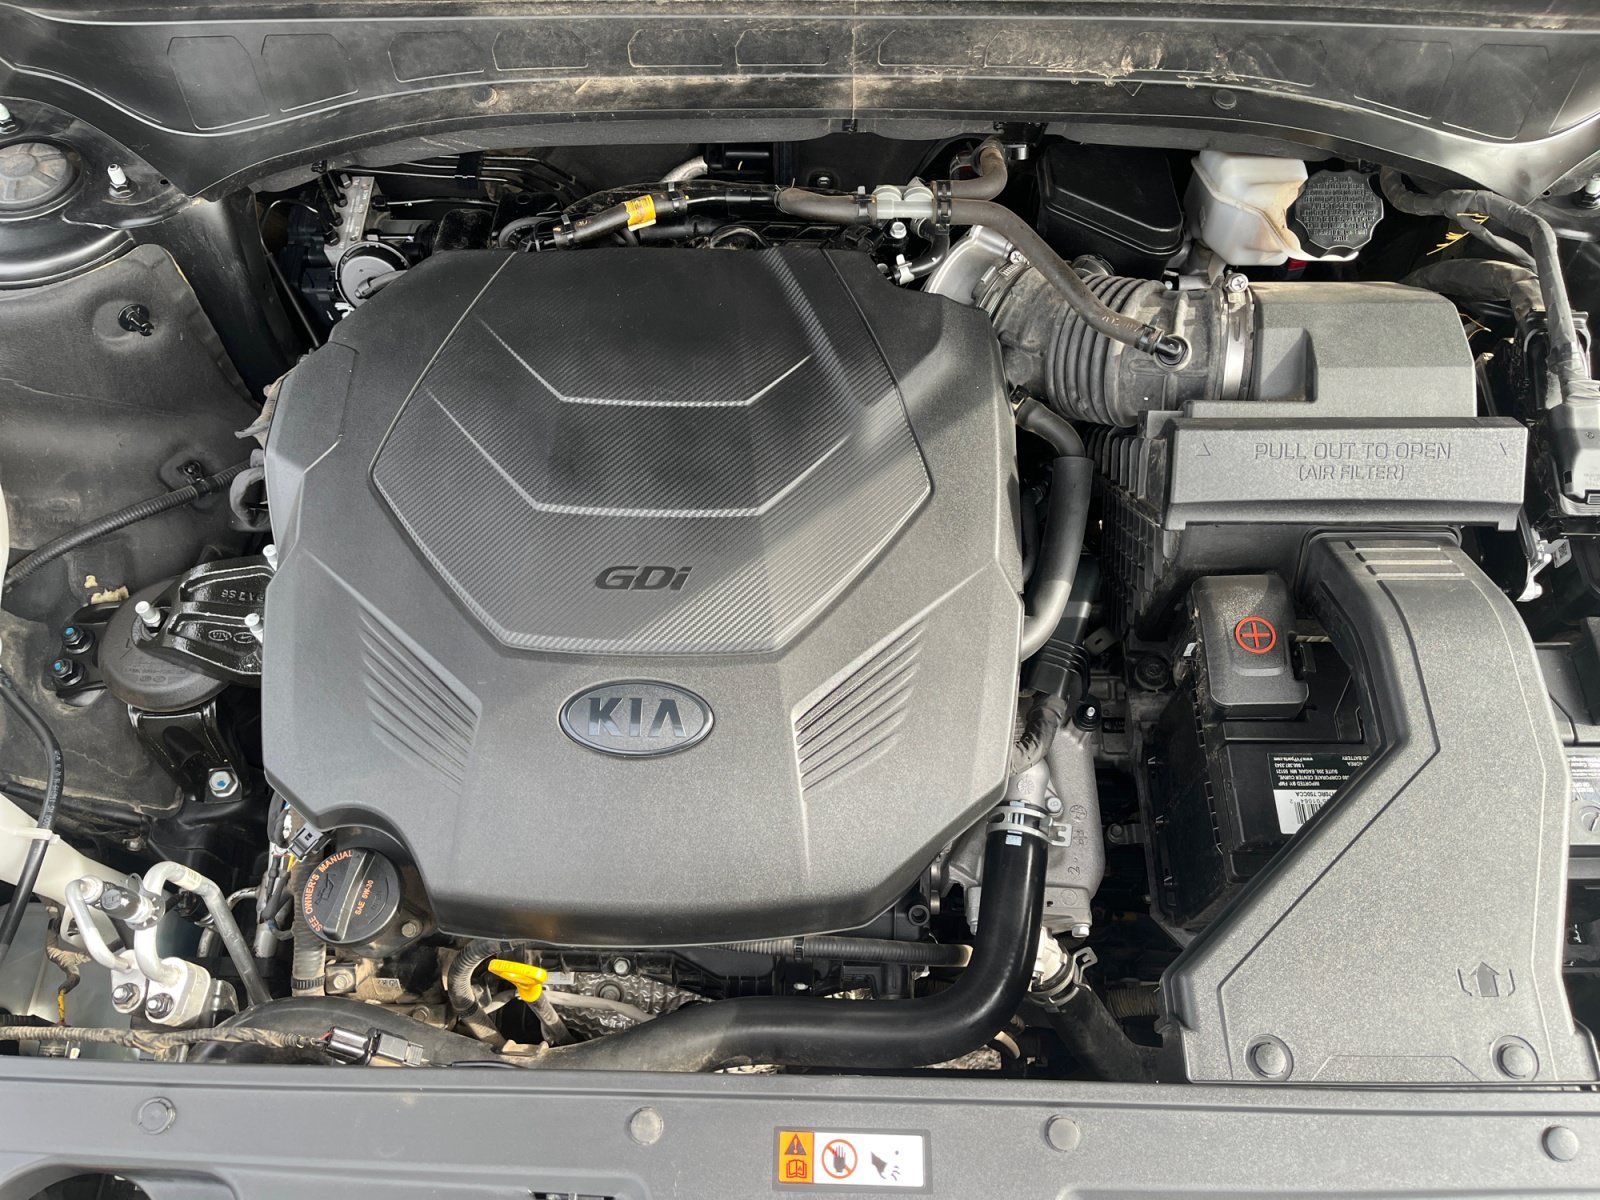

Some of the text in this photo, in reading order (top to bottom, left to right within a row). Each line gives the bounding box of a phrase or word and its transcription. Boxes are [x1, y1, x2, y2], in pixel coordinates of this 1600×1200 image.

[1255, 442, 1451, 460] PULL OUT TO OPEN
[1299, 464, 1405, 481] (AIR FILTER)
[595, 566, 693, 590] GDi
[588, 697, 687, 737] KIA
[304, 849, 353, 932] SEE OWNER'S MANUAL
[354, 900, 366, 915] SAE
